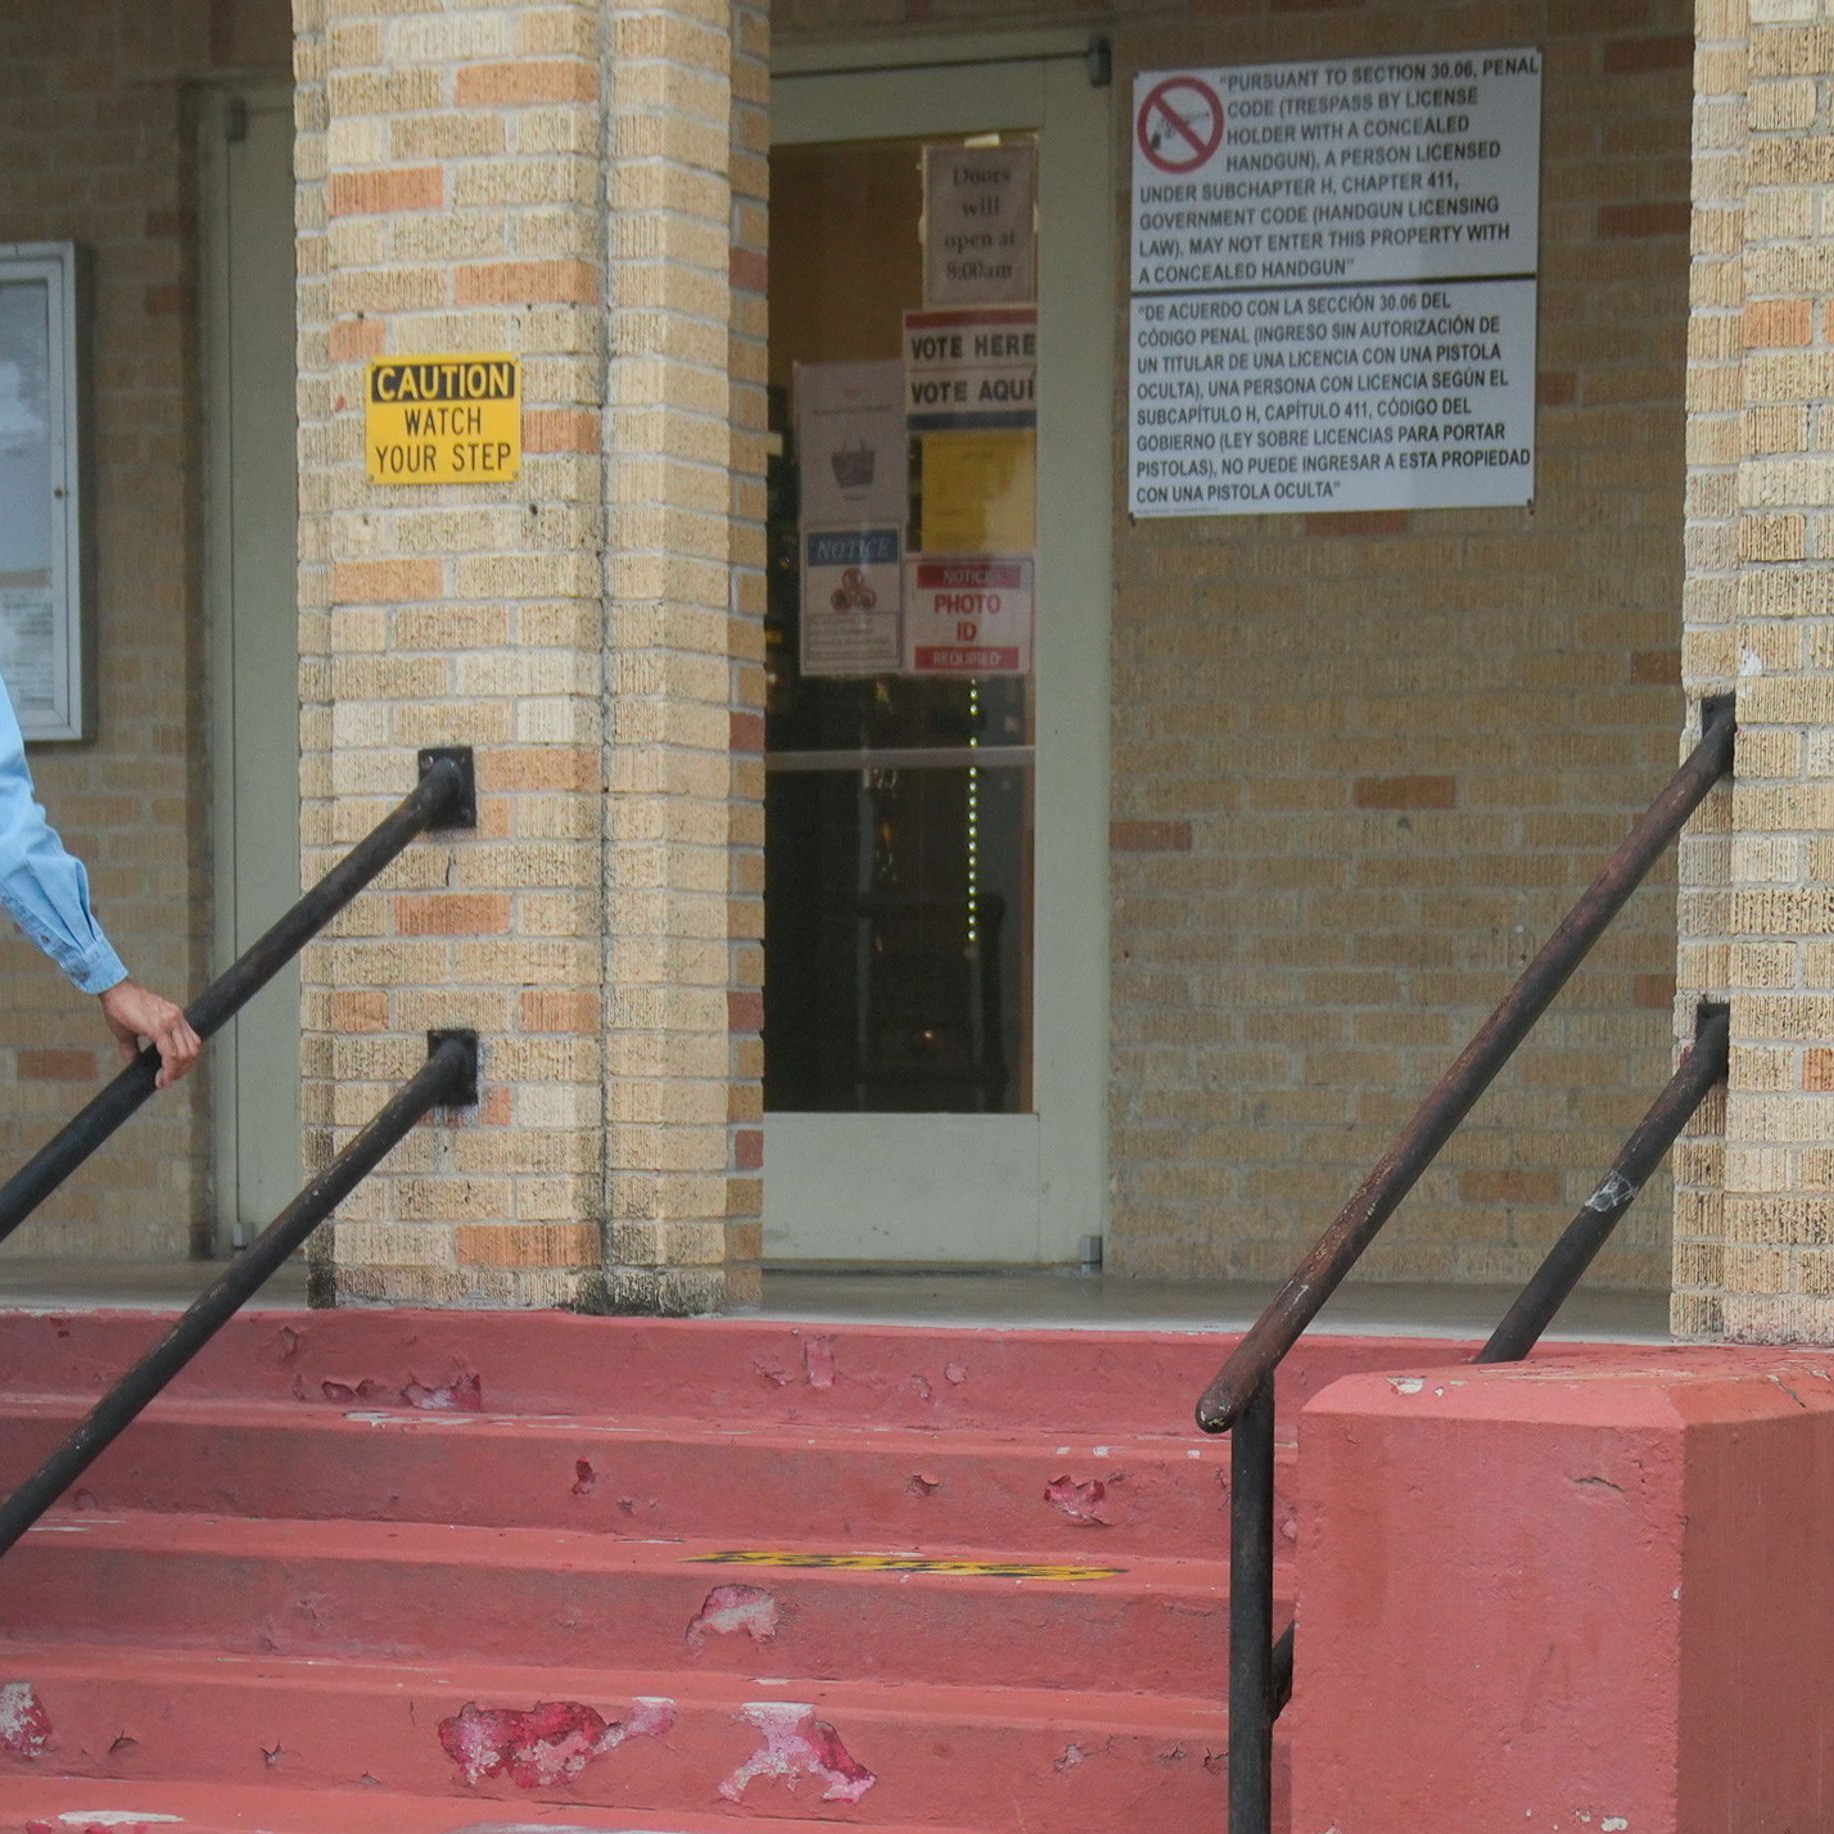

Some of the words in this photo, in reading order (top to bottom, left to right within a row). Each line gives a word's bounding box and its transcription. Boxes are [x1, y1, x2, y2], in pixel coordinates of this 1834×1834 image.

[1326, 68, 1347, 86] TO
[1352, 65, 1425, 85] SECTION
[1432, 62, 1477, 79] 30.06,
[1482, 57, 1538, 76] PENAL
[1227, 101, 1270, 118] CODE
[1279, 94, 1372, 118] (TRESPASS
[1378, 93, 1400, 109] BY
[1406, 87, 1478, 107] LICENSE
[1227, 126, 1295, 145] HOLDER
[1301, 124, 1342, 140] WITH
[1348, 124, 1359, 138] A
[1364, 116, 1469, 137] CONCEALED
[1226, 152, 1320, 172] HANDGUN),
[1325, 150, 1335, 166] A
[1341, 146, 1411, 164] PERSON
[1417, 140, 1500, 162] LICENSED
[952, 168, 1011, 186] Doors
[1140, 185, 1197, 204] UNDER
[1202, 179, 1315, 201] SUBCHAPTER
[1321, 178, 1337, 196] H,
[1342, 173, 1422, 193] CHAPTER
[1427, 172, 1458, 190] 411,
[962, 198, 999, 217] will
[1140, 210, 1255, 230] GOVERNMENT
[1261, 207, 1307, 224] CODE
[1313, 202, 1402, 225] (HANDGUN
[1408, 196, 1499, 217] LICENSING
[944, 232, 992, 253] open
[998, 229, 1015, 246] at
[1140, 239, 1184, 258] LAW),
[1189, 236, 1223, 254] MAY
[1228, 235, 1261, 252] NOT
[1268, 231, 1325, 250] ENTER
[1331, 230, 1365, 247] THIS
[1371, 226, 1461, 246] PROPERTY
[1467, 223, 1510, 241] WITH
[947, 260, 1012, 281] 8:00am
[1139, 269, 1150, 284] A
[1154, 263, 1256, 283] CONCEALED
[1169, 301, 1241, 320] ACUERDO
[1247, 300, 1279, 316] CON
[1284, 299, 1303, 315] LA
[1308, 292, 1374, 315] SECCIÓN
[1380, 294, 1416, 310] 30.06
[1422, 292, 1450, 309] DEL
[1138, 325, 1195, 347] CÓDIGO
[1201, 327, 1249, 345] PENAL
[1255, 325, 1327, 347] (INGRESO
[1332, 323, 1355, 338] SIN
[1360, 314, 1475, 337] AUTORIZACIÓN
[1480, 316, 1500, 333] DE
[911, 335, 963, 360] VOTE
[974, 333, 1036, 357] HERE
[1138, 356, 1158, 374] UN
[1162, 354, 1224, 372] TITULAR
[1229, 353, 1249, 369] DE
[1254, 352, 1283, 368] UNA
[1289, 348, 1358, 366] LICENCIA
[1362, 347, 1395, 364] CON
[1400, 346, 1431, 363] UNA
[1437, 343, 1501, 361] PISTOLA
[377, 364, 508, 400] CAUTION
[911, 380, 966, 404] VOTE
[978, 368, 1036, 401] AQUÍ
[1138, 382, 1203, 400] OCULTA),
[1208, 380, 1239, 396] UNA
[1244, 377, 1316, 395] PERSONA
[1322, 375, 1352, 392] CON
[1358, 373, 1427, 391] LICENCIA
[1432, 367, 1484, 388] SEGÚN
[1490, 369, 1508, 385] EL
[405, 407, 481, 436] WATCH
[1138, 403, 1241, 426] SUBCAPÍTULO
[1247, 407, 1261, 424] H,
[1266, 399, 1340, 421] CAPÍTULO
[1345, 401, 1372, 420] 411,
[1377, 398, 1437, 416] CÓDIGO
[1442, 397, 1471, 413] DEL
[1137, 433, 1215, 452] GOBIERNO
[1220, 433, 1253, 453] (LEY
[1258, 430, 1308, 447] SOBRE
[1314, 427, 1393, 445] LICENCIAS
[1398, 426, 1438, 442] PARA
[1444, 422, 1505, 440] PORTAR
[376, 445, 437, 473] YOUR
[452, 442, 511, 471] STEP
[1137, 459, 1217, 478] PISTOLAS),
[1222, 458, 1243, 475] NO
[1248, 455, 1297, 473] PUEDE
[1303, 453, 1380, 472] INGRESAR
[1384, 454, 1394, 470] A
[1400, 451, 1437, 468] ESTA
[1442, 448, 1530, 467] PROPIEDAD
[1136, 486, 1167, 503] CON
[1172, 484, 1203, 501] UNA
[1208, 482, 1269, 500] PISTOLA
[816, 538, 890, 560] NOTICE
[934, 593, 1001, 615] PHOTO
[956, 622, 977, 642] ID
[934, 651, 999, 665] REQUIRED
